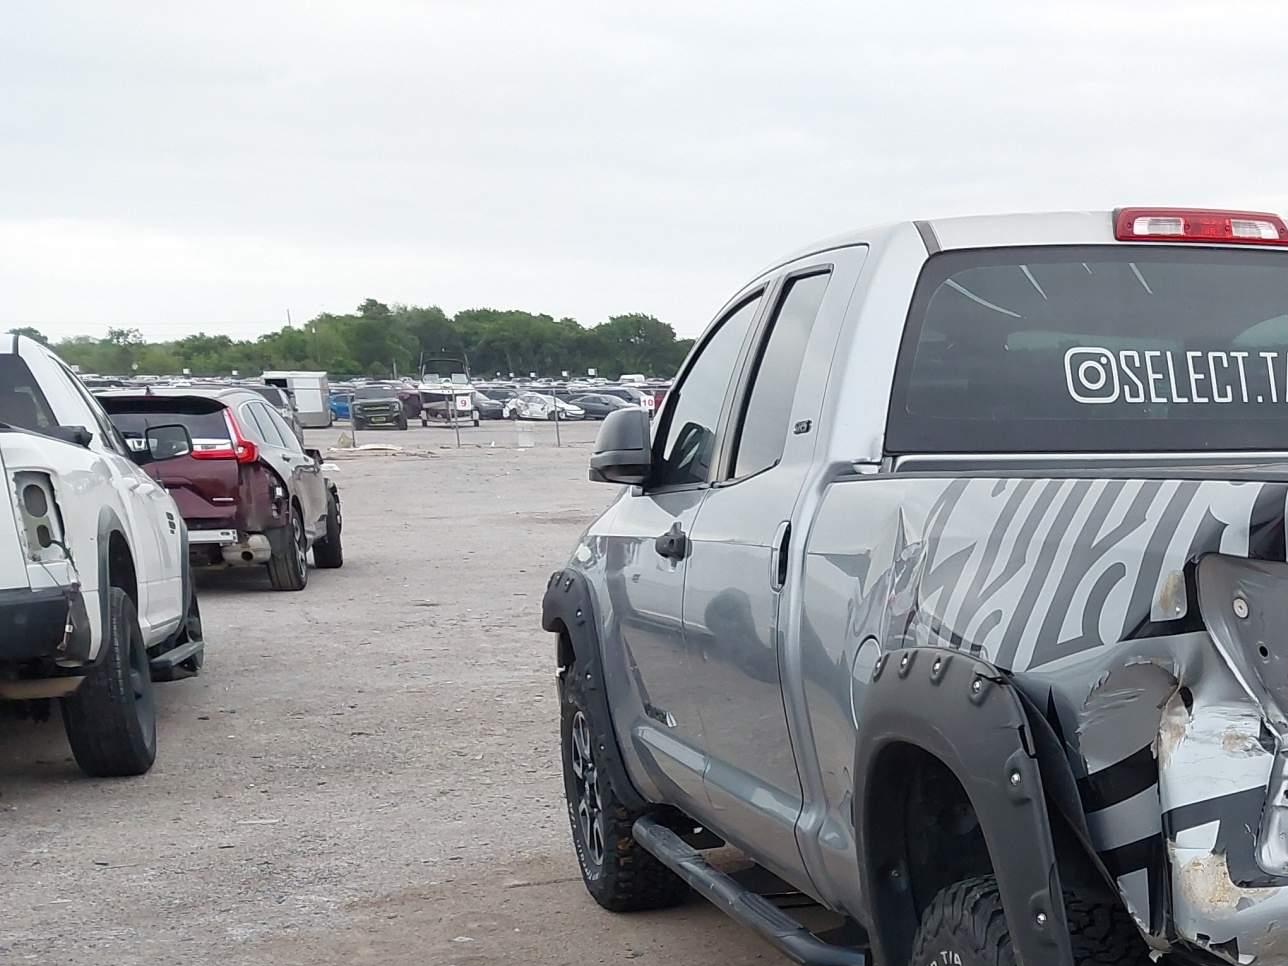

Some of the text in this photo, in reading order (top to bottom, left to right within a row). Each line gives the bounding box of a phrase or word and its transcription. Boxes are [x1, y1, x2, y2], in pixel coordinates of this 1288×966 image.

[460, 399, 467, 409] 9
[641, 398, 654, 407] 10
[939, 948, 964, 966] T/A
